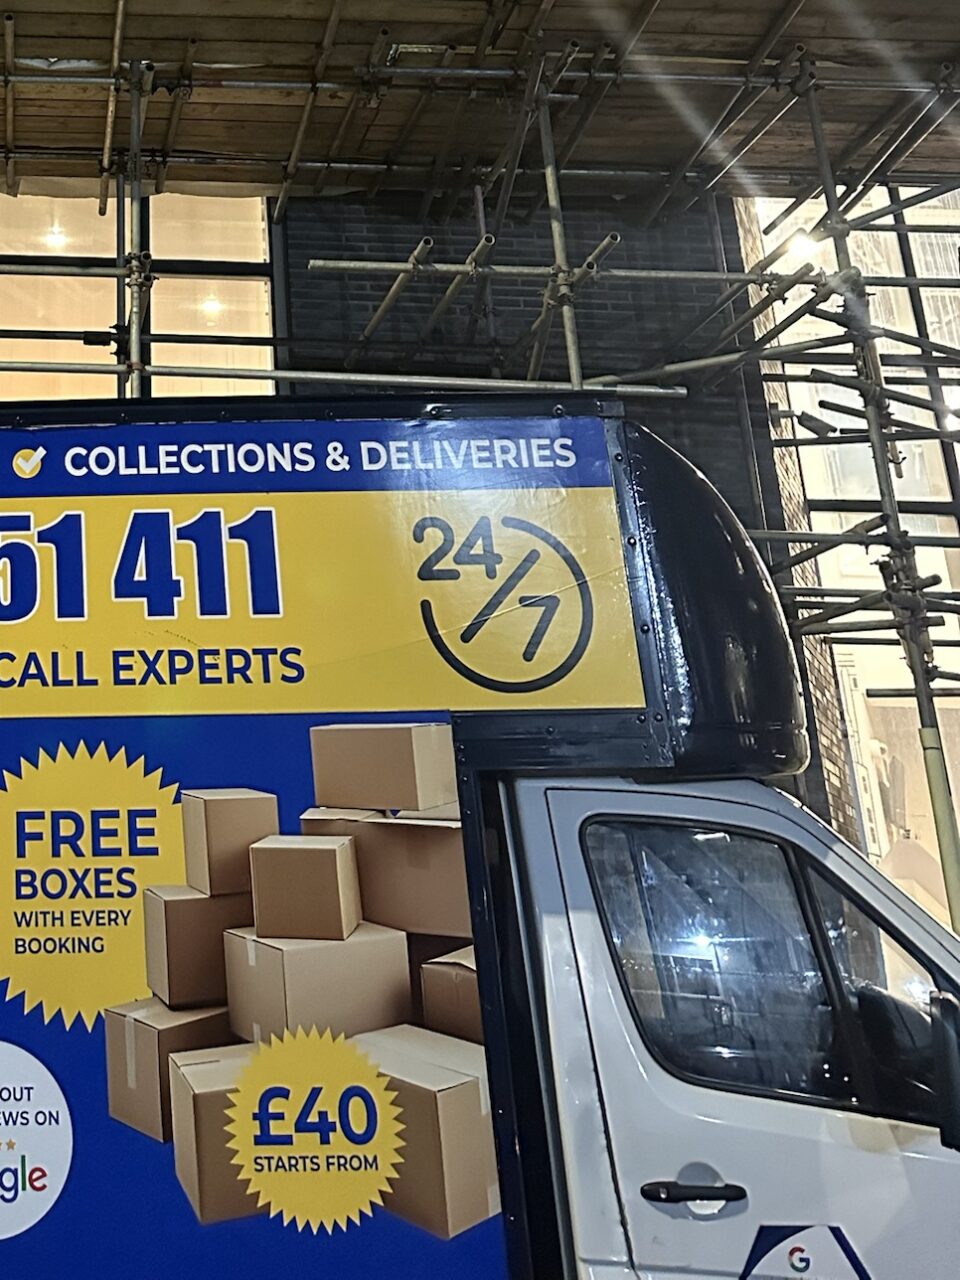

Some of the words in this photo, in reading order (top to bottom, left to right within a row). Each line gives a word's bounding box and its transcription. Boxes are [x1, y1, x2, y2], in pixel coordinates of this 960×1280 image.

[65, 442, 315, 476] COLLECTIONS
[326, 442, 350, 471] &
[360, 438, 577, 471] DELIVERIES
[114, 509, 281, 616] 411
[113, 648, 304, 685] EXPERTS
[16, 809, 159, 858] FREE
[16, 867, 136, 900] BOXES
[14, 911, 63, 927] WITH
[71, 910, 131, 926] EVERY
[15, 937, 104, 954] BOOKING
[0, 1087, 33, 1101] OUT
[35, 1111, 59, 1125] ON
[252, 1086, 377, 1146] £40
[254, 1156, 320, 1172] STARTS
[326, 1155, 378, 1171] FROM
